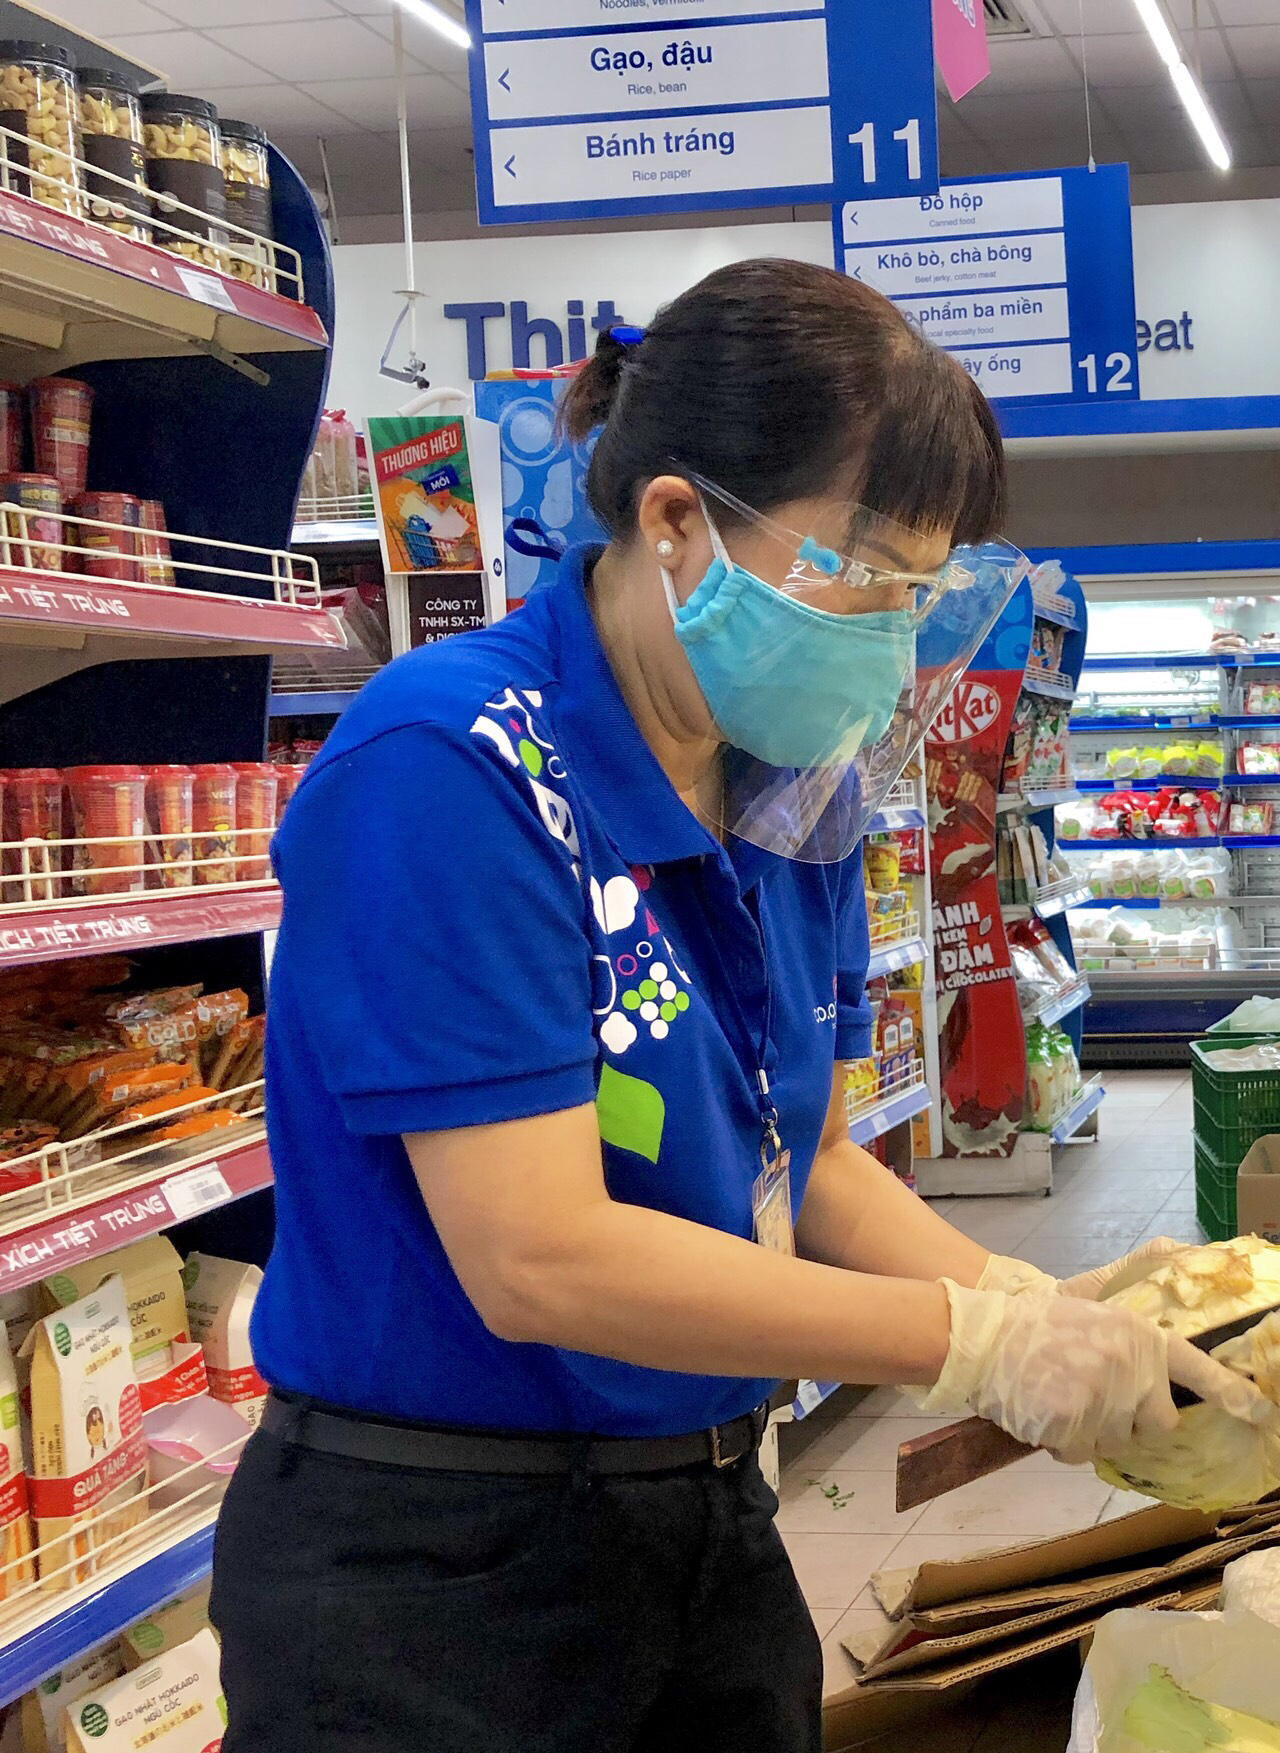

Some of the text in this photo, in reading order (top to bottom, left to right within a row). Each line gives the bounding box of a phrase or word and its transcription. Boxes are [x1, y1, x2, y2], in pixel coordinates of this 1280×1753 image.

[590, 40, 713, 77] Gạo, đậu
[627, 80, 688, 96] Rice, bean
[586, 127, 736, 159] Bánh tráng
[848, 118, 922, 184] 11
[632, 167, 692, 183] Rice paper
[949, 192, 984, 213] hộp
[877, 245, 1033, 270] Khô bò, chà bông
[919, 302, 968, 326] phẩm
[973, 303, 995, 319] ba
[1000, 296, 1043, 317] miền
[1136, 311, 1195, 352] eat
[988, 353, 1022, 374] ống
[1077, 352, 1133, 394] 12
[429, 429, 458, 456] HIỆU
[12, 584, 59, 613] TIỆT
[61, 591, 131, 617] TRÙNG
[425, 597, 477, 611] CÔNG TY
[418, 616, 449, 628] TNHH
[35, 919, 82, 950] TIỆT
[83, 913, 153, 940] TRÙNG
[932, 900, 980, 932] ÁNH
[940, 941, 995, 975] ĐẬM
[52, 1219, 98, 1249] TIỆT
[100, 1194, 167, 1232] TRÙNG
